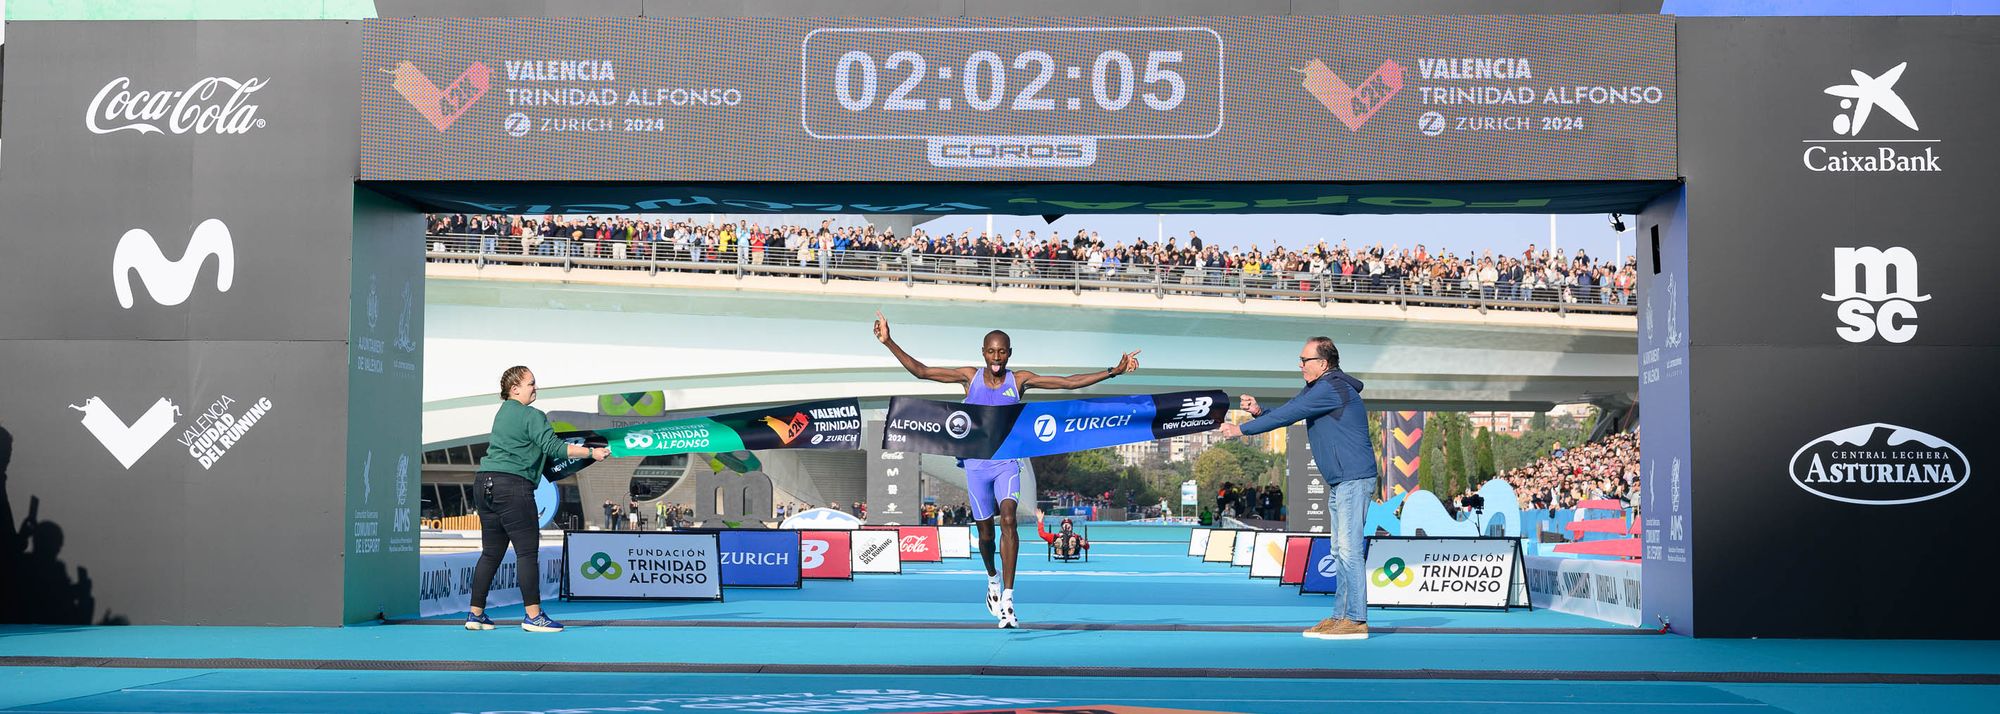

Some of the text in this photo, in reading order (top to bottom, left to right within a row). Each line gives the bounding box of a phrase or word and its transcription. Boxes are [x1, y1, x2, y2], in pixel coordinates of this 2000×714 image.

[505, 60, 615, 81] VALENCIA
[1419, 58, 1531, 79] VALENCIA
[835, 50, 1186, 111] 02:02:05
[507, 88, 742, 106] TRINIDAD ALFONSO
[1420, 86, 1662, 104] TRINIDAD ALFONSO
[540, 118, 613, 131] ZURICH
[624, 118, 665, 131] 2024
[1456, 117, 1530, 130] ZURICH
[1542, 117, 1583, 130] 2024
[941, 145, 1082, 158] COROS
[1803, 146, 1942, 172] CaixaBank
[810, 406, 858, 419] VALENCIA
[177, 394, 236, 447] VALENCIA
[814, 420, 860, 431] TRINIDAD
[889, 418, 941, 432] ALFONSO
[1064, 415, 1131, 432] ZURICH
[1163, 419, 1214, 430] new balance
[198, 397, 273, 470] DEL RUNNING
[655, 429, 709, 440] TRINIDAD
[788, 420, 805, 438] 42K
[189, 413, 235, 459] CIUDAD
[888, 434, 906, 442] 2024
[655, 439, 709, 449] ALFONSO
[1832, 451, 1949, 460] CENTRAL LECHERA
[1805, 453, 1956, 483] ASTURIANA
[393, 508, 410, 532] AIMS
[628, 548, 705, 557] FUNDACIÓN
[859, 544, 877, 561] CIUDAD
[864, 554, 874, 564] DEL
[873, 538, 893, 558] RUNNING
[1424, 553, 1505, 562] FUNDACIÓN
[628, 559, 706, 571] TRINIDAD
[721, 552, 789, 565] ZURICH
[1422, 565, 1503, 578] TRINIDAD
[420, 562, 452, 602] ALAQUÀS
[629, 573, 707, 584] ALFONSO
[1419, 580, 1501, 593] ALFONSO
